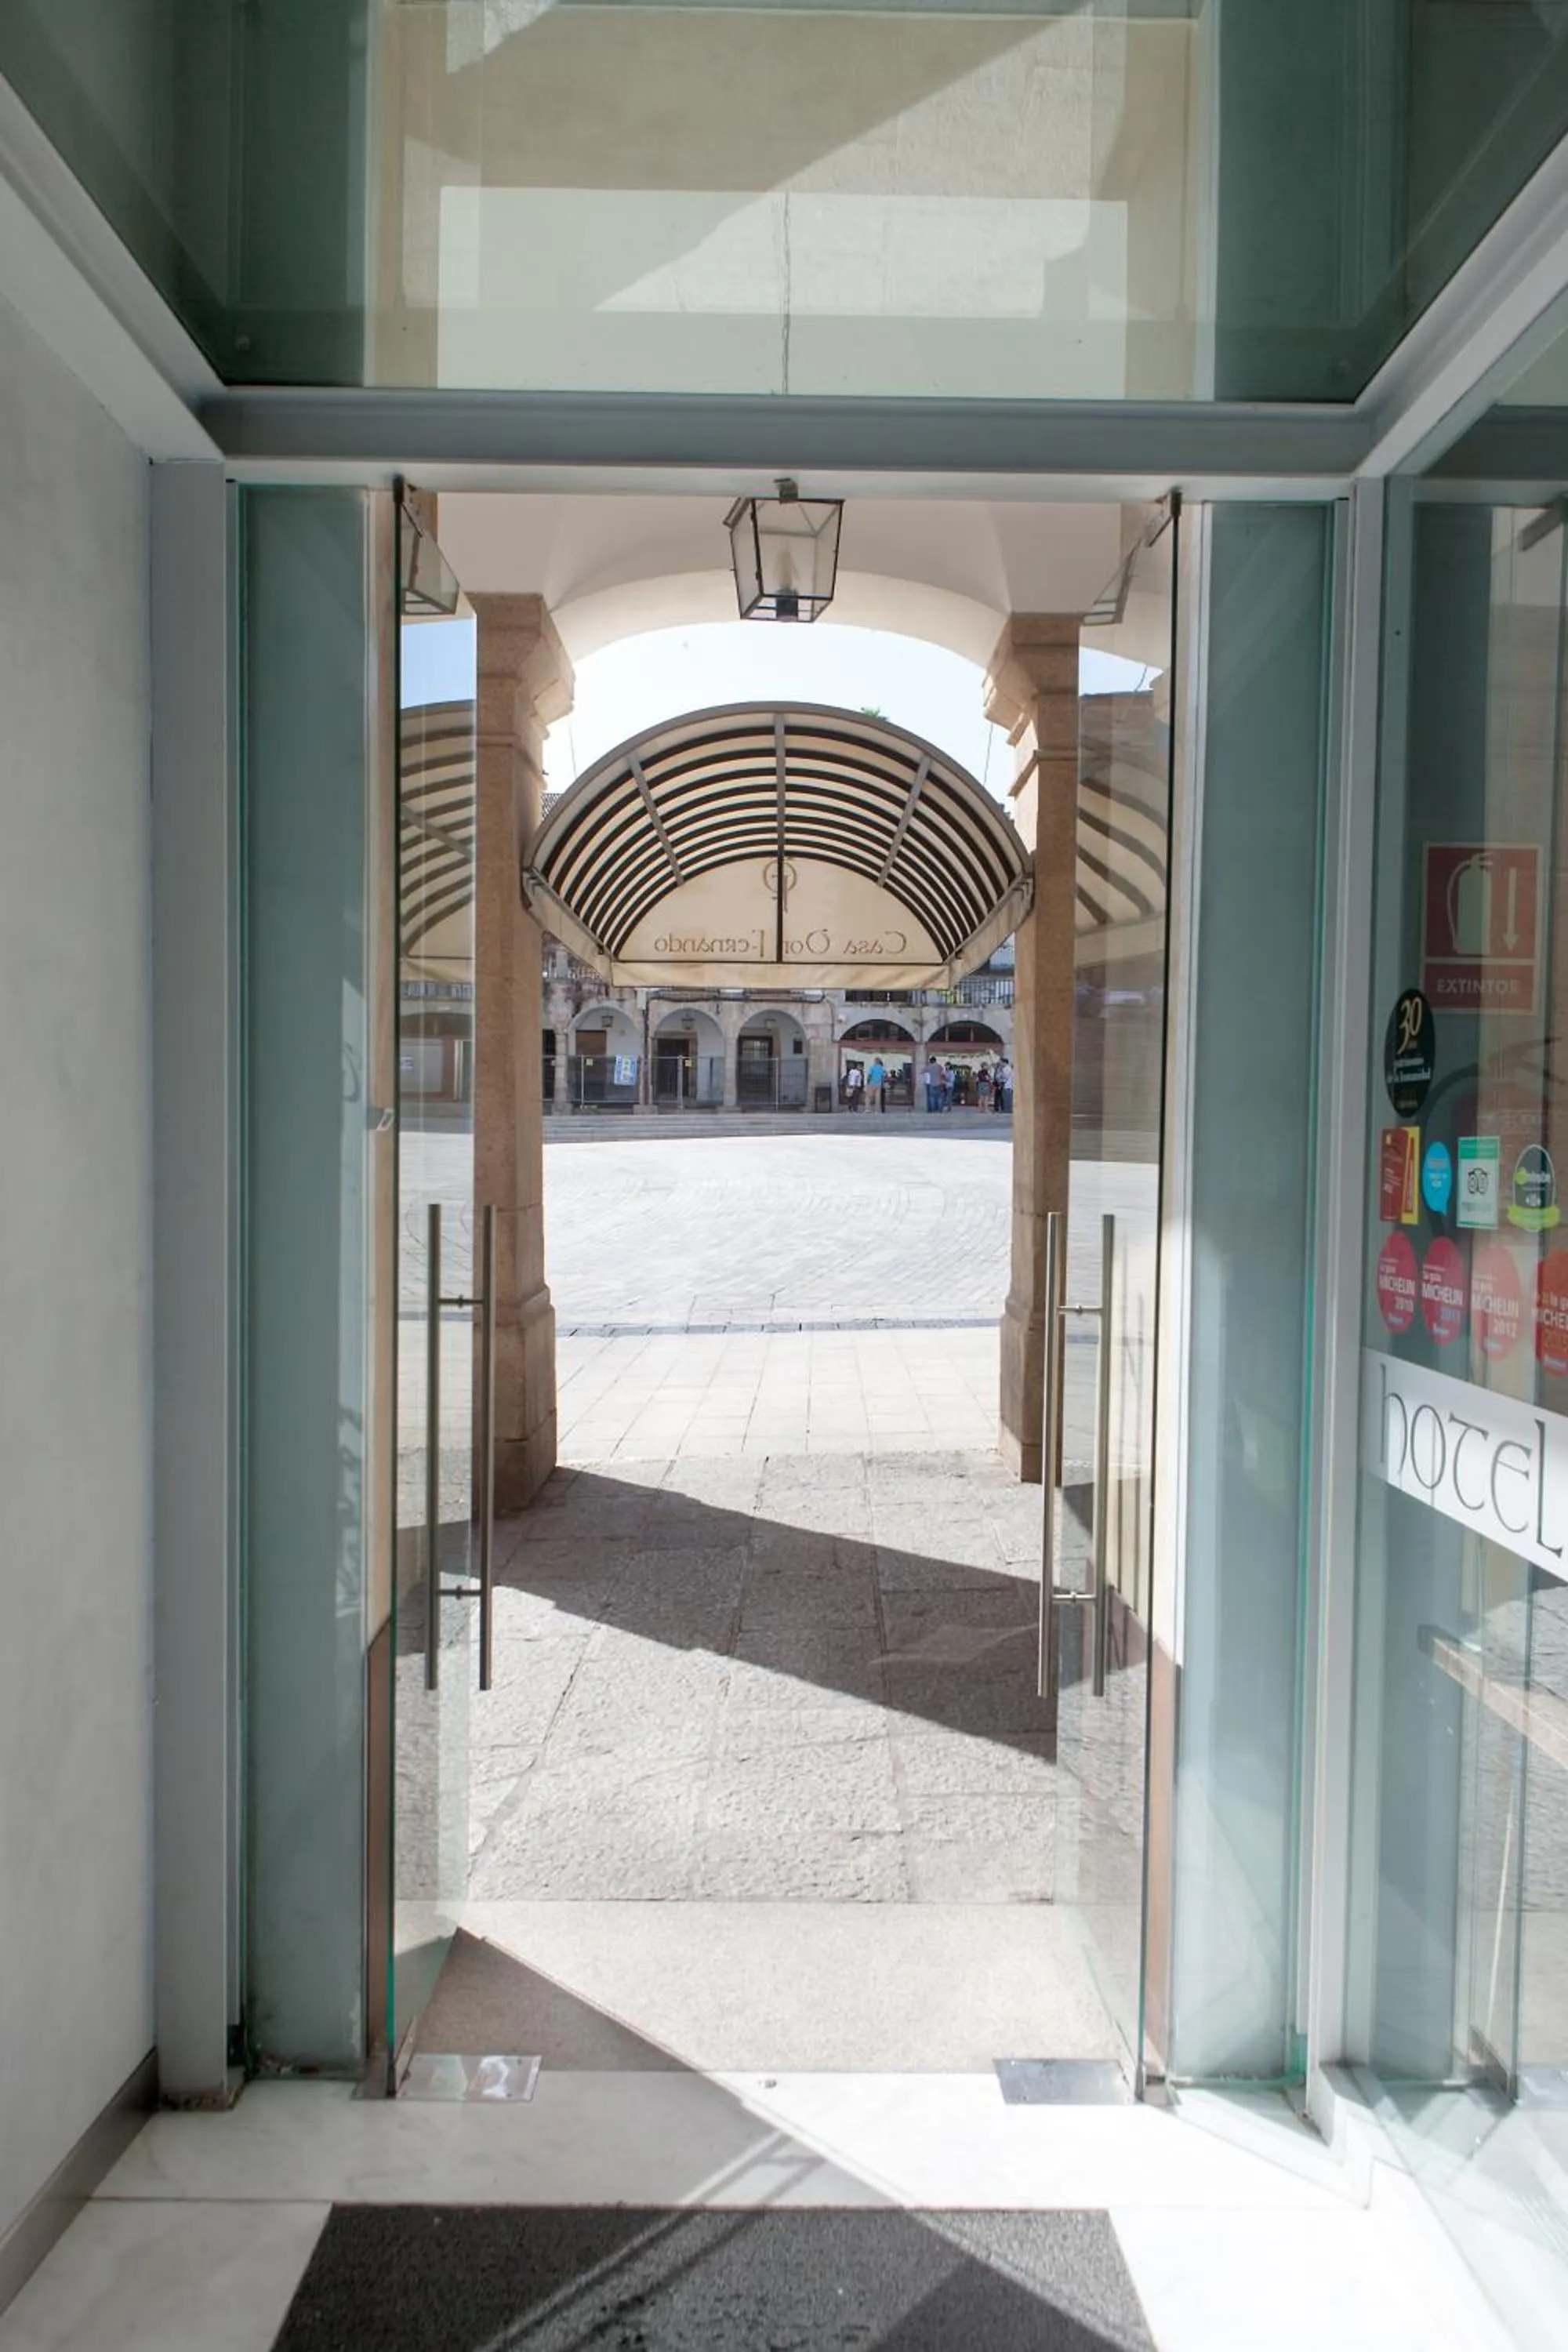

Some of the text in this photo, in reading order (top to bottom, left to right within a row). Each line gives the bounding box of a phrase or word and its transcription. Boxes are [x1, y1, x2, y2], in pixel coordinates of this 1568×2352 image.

[1436, 978, 1520, 994] EXTINTOR
[1378, 1274, 1416, 1298] MICHELIN
[1421, 1282, 1464, 1307] MICHELIN
[1471, 1292, 1519, 1319] MICHELIN
